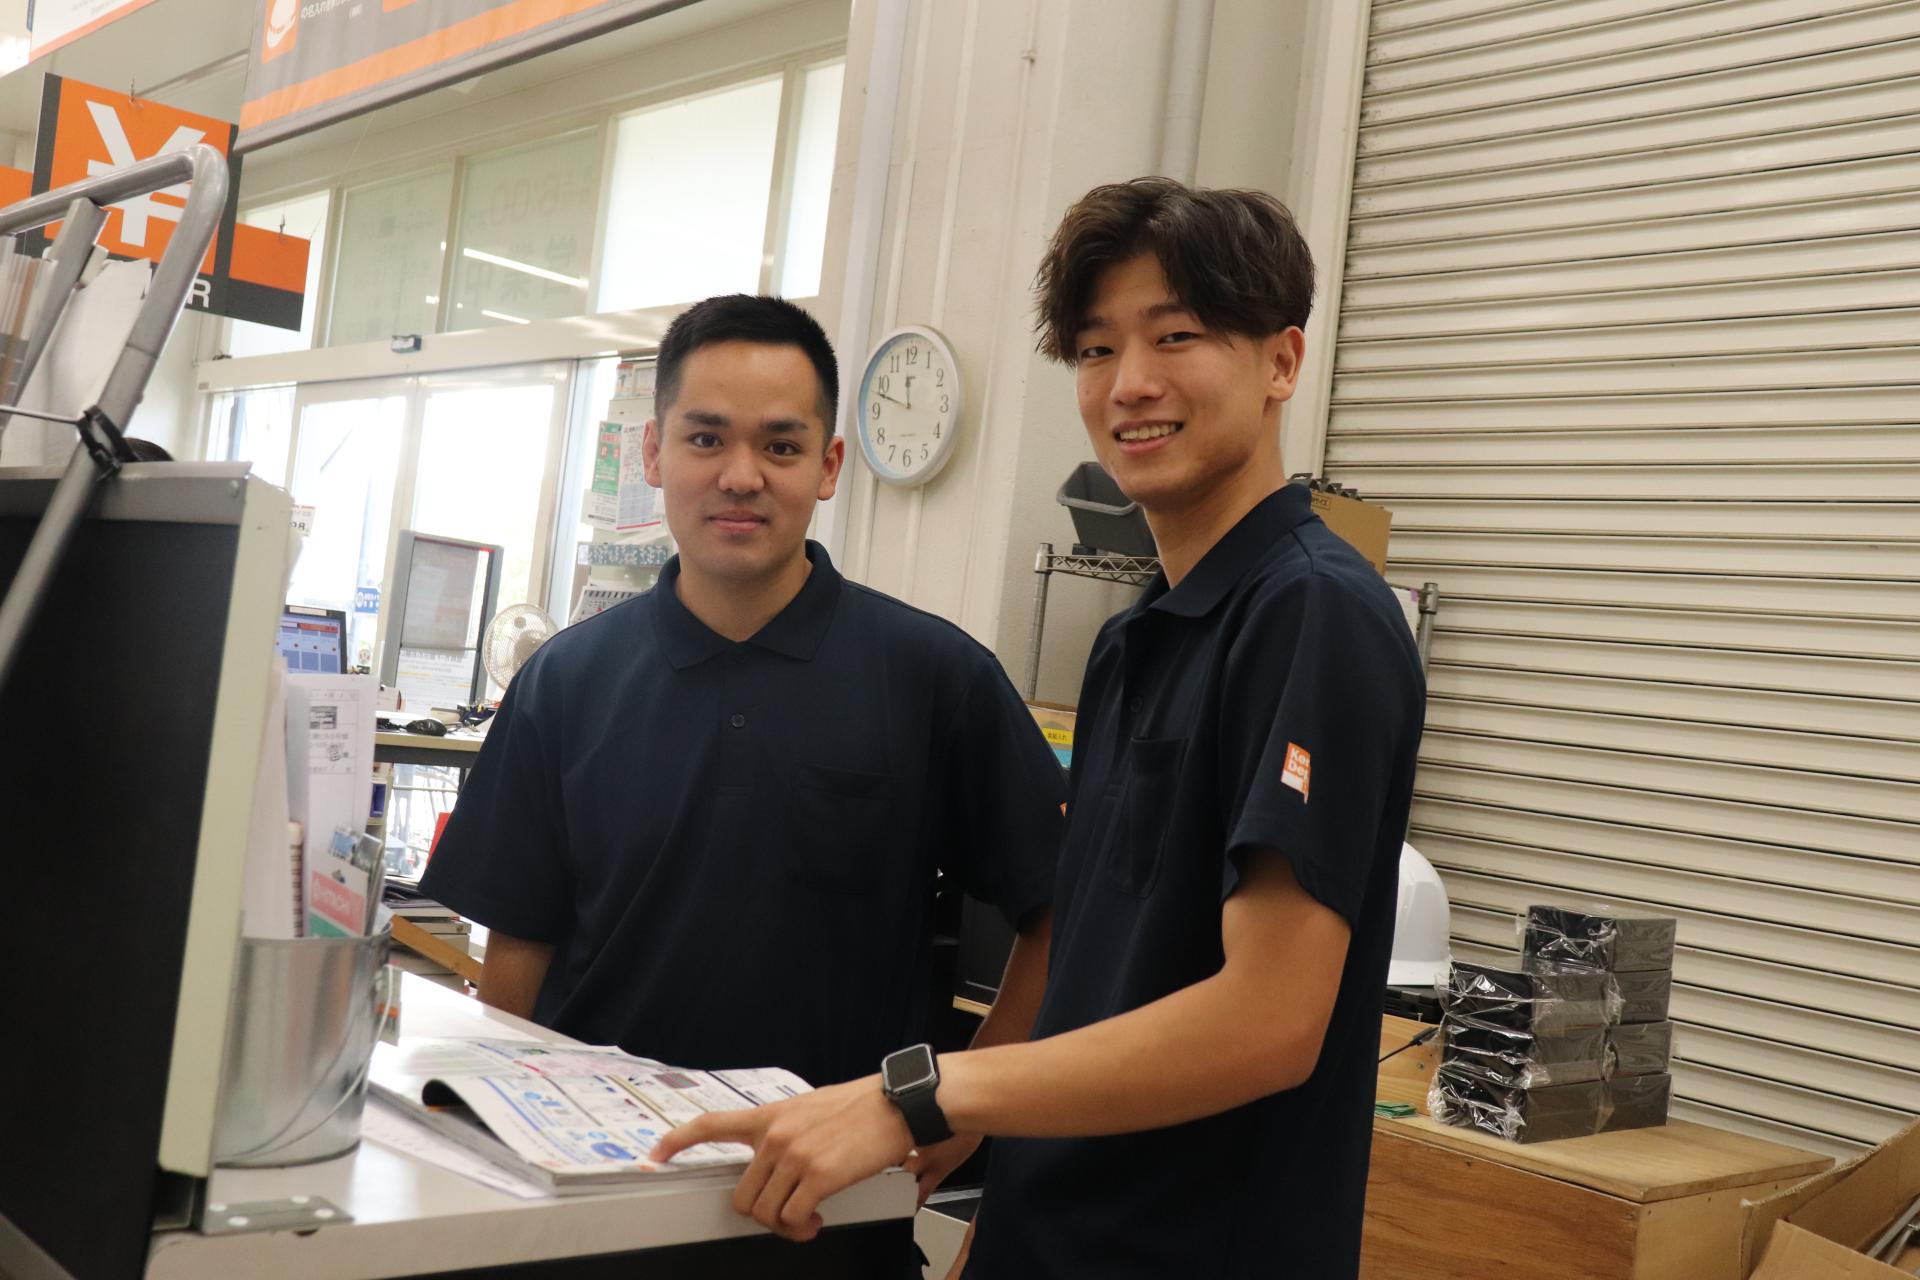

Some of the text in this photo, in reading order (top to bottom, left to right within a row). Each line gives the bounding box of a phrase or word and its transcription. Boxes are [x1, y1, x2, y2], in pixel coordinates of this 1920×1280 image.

[890, 355, 900, 373] 11
[906, 345, 918, 365] 12
[926, 351, 931, 369] 1
[878, 375, 890, 393] 10
[936, 368, 944, 387] 2
[872, 402, 881, 420] 9
[940, 394, 949, 413] 3
[877, 427, 886, 445] 8
[933, 421, 941, 439] 4
[888, 445, 897, 463] 7
[902, 449, 912, 468] 6
[920, 443, 929, 461] 5
